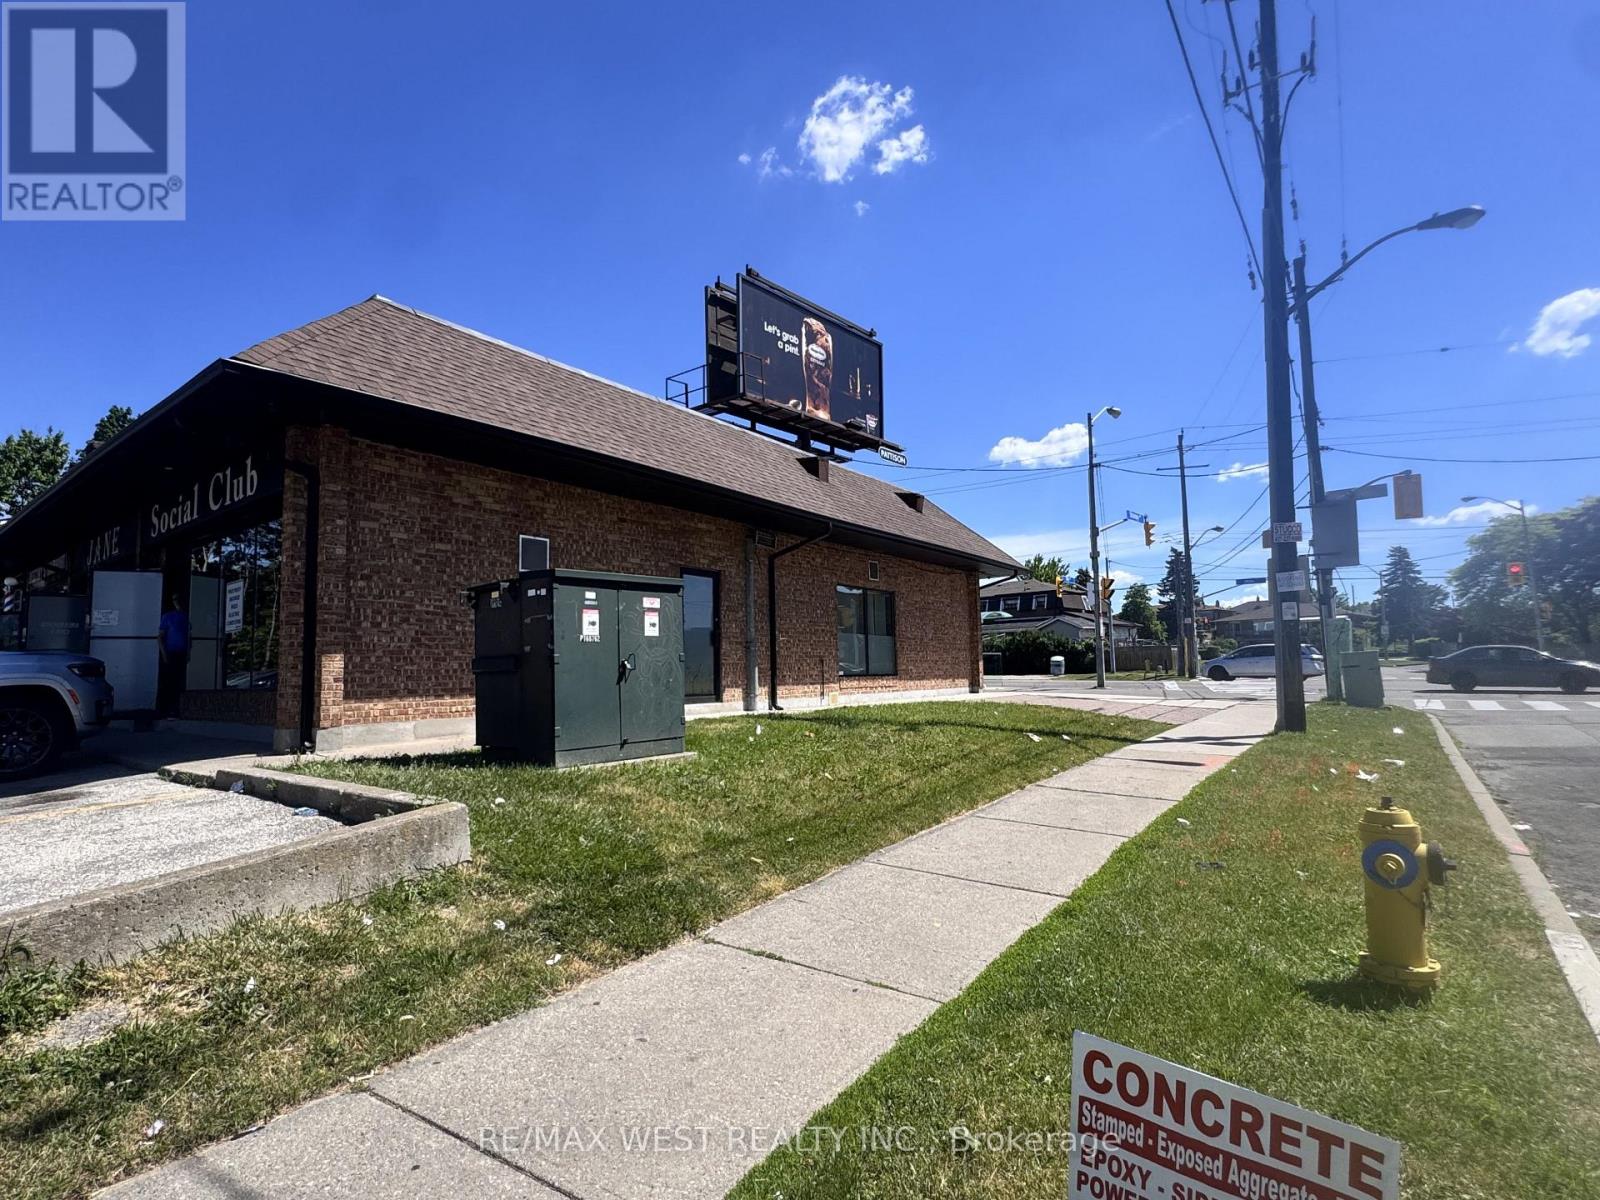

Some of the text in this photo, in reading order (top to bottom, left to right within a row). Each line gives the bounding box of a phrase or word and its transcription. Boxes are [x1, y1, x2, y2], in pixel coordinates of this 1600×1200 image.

[764, 321, 799, 344] Let's grab
[777, 340, 784, 349] a
[86, 455, 258, 565] JANE Social Club
[1081, 1101, 1144, 1148] Stamped
[1157, 1130, 1223, 1180] Exposed
[1083, 1050, 1385, 1199] CONCRETE
[1081, 1144, 1152, 1191] EPOXY
